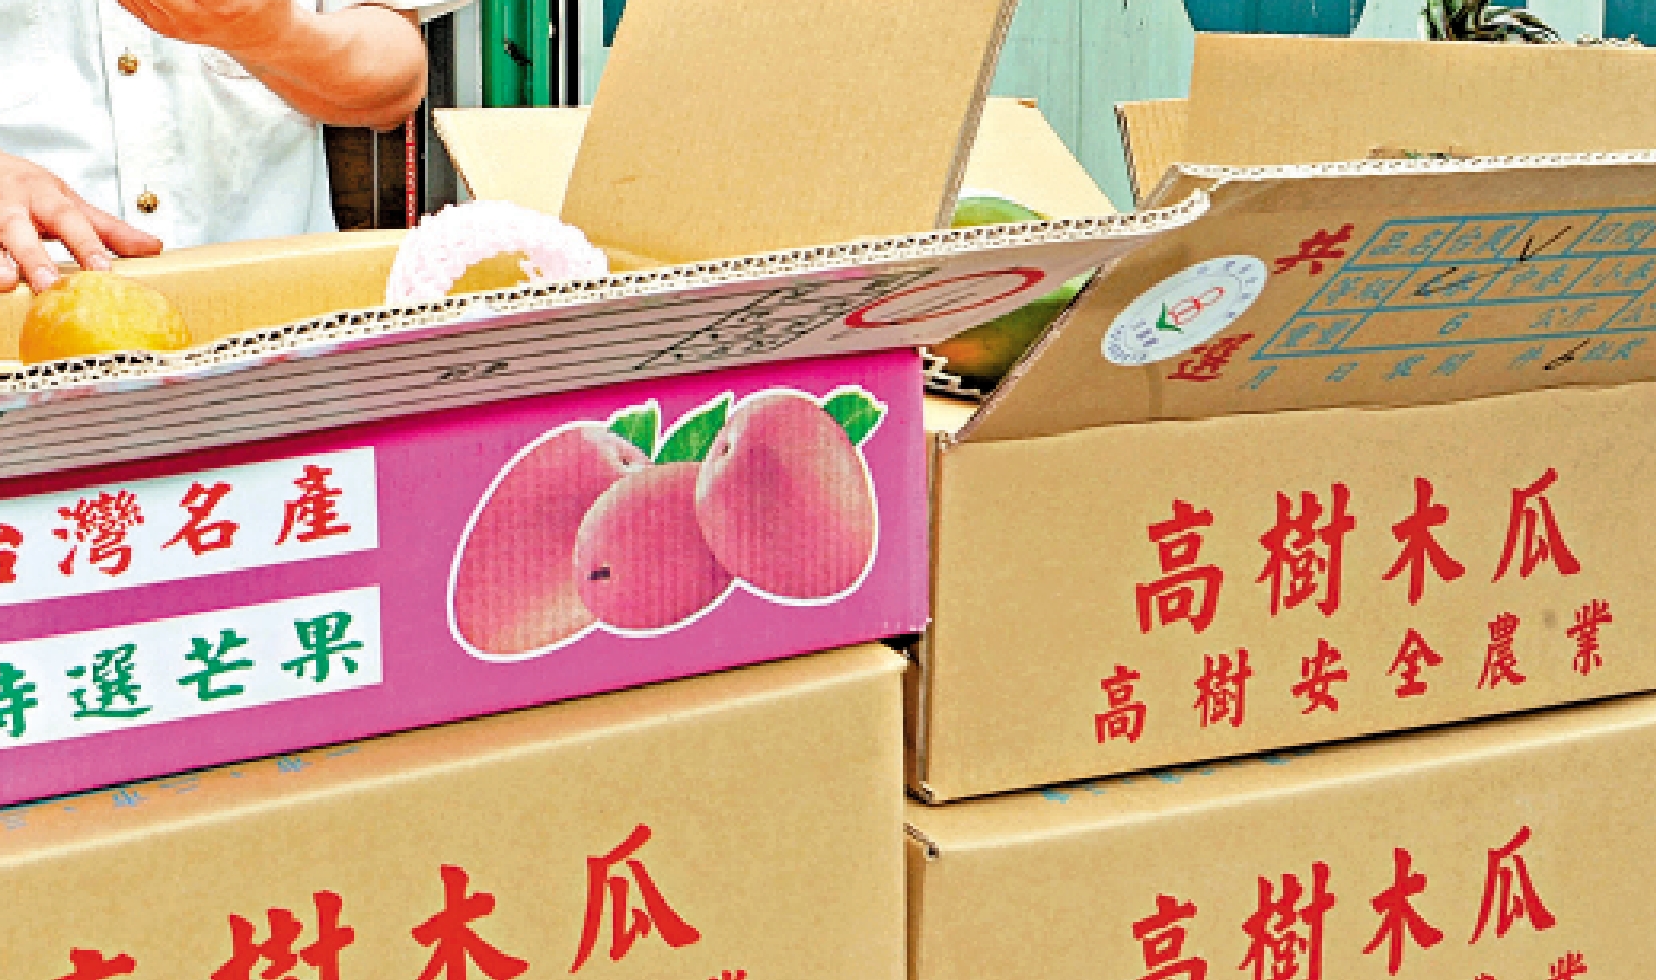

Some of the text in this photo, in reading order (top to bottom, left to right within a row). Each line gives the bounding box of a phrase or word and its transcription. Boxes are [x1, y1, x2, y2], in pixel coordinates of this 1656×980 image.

[1135, 467, 1582, 635] 高樹木瓜
[1094, 598, 1614, 745] 高樹安全農業
[49, 823, 701, 980] 木瓜
